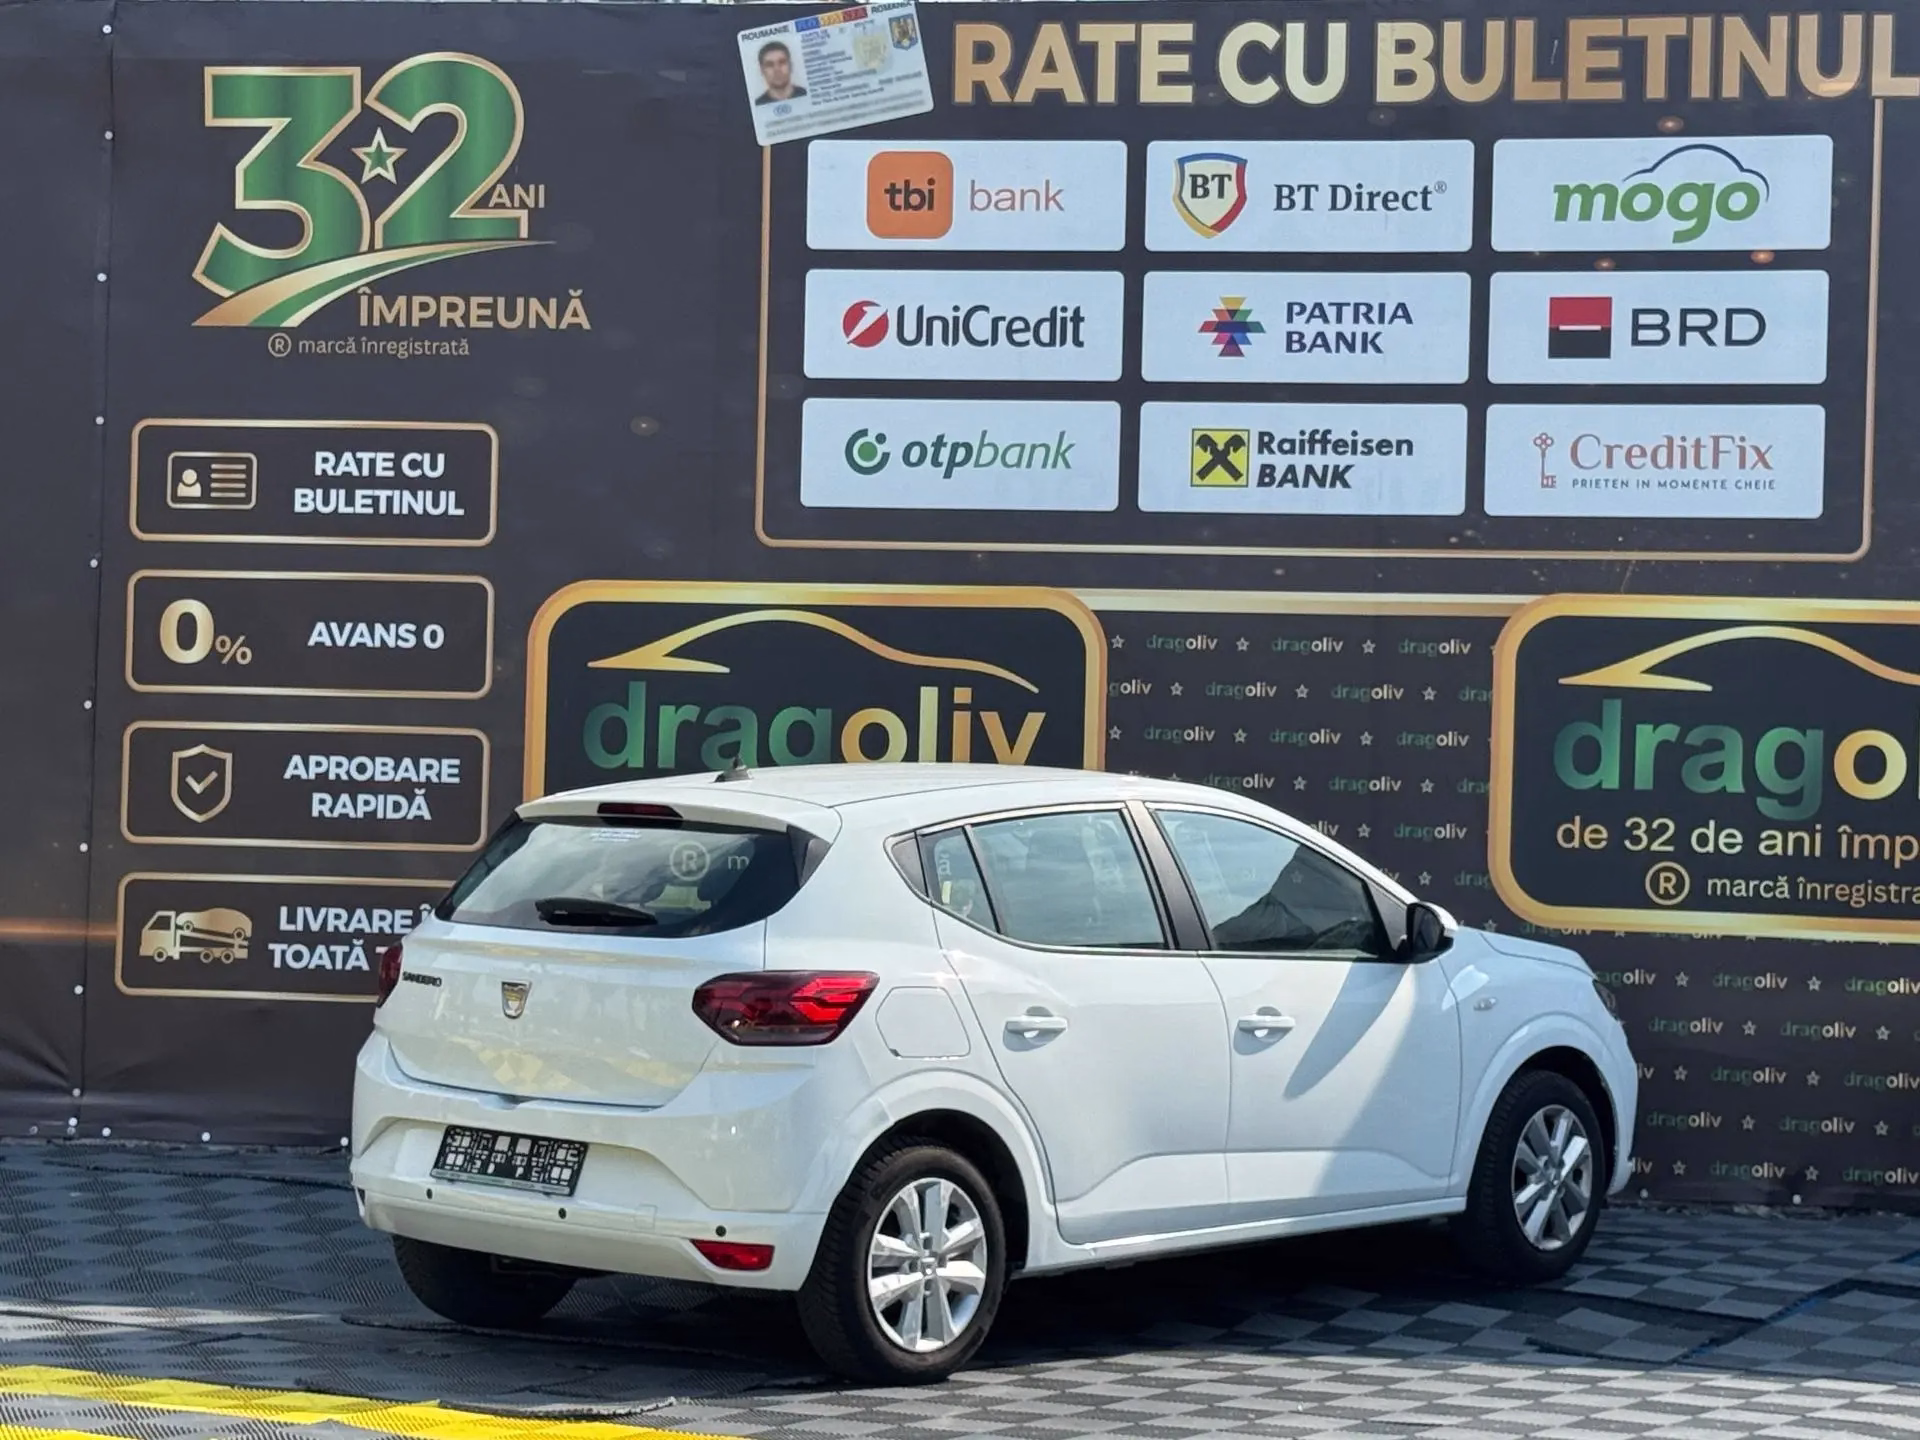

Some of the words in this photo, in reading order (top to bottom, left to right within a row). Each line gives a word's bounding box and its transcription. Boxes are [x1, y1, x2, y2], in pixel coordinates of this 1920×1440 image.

[953, 22, 1195, 104] RATE
[1218, 21, 1348, 105] CU
[1375, 14, 1920, 103] BULETINUL
[192, 51, 528, 298] 32
[488, 183, 546, 209] ANI
[1188, 173, 1233, 201] BT
[884, 177, 936, 212] tbi
[969, 179, 1065, 212] bank
[1273, 183, 1319, 212] BT
[1553, 181, 1761, 244] mogo
[359, 287, 592, 330] ÎMPREUNĂ
[1285, 301, 1414, 326] PATRIA
[895, 304, 1086, 349] UniCredit
[1630, 307, 1768, 347] BRD
[298, 336, 357, 356] marcă
[361, 335, 470, 359] înregistrată
[1285, 330, 1385, 355] BANK
[1257, 429, 1414, 457] Raiffeisen
[1570, 433, 1775, 470] CreditFix
[314, 450, 395, 478] RATE
[401, 452, 446, 479] CU
[1256, 464, 1355, 489] BANK
[1572, 478, 1630, 490] PRIETEN
[1636, 479, 1651, 489] IN
[1657, 479, 1728, 490] MOMENTE
[1734, 479, 1777, 490] CHEIE
[293, 488, 465, 516] BULETINUL
[307, 621, 417, 649] AVANS
[422, 623, 445, 649] 0
[283, 754, 461, 784] APROBARE
[1553, 698, 1920, 820] drago
[311, 787, 432, 821] RAPIDĂ
[1556, 815, 1609, 849] de
[1623, 816, 1677, 852] 32
[1690, 820, 1745, 854] de
[1758, 823, 1822, 858] ani
[1707, 875, 1791, 900] marcă
[279, 905, 413, 935] LIVRARE
[268, 938, 370, 972] TOATĂ
